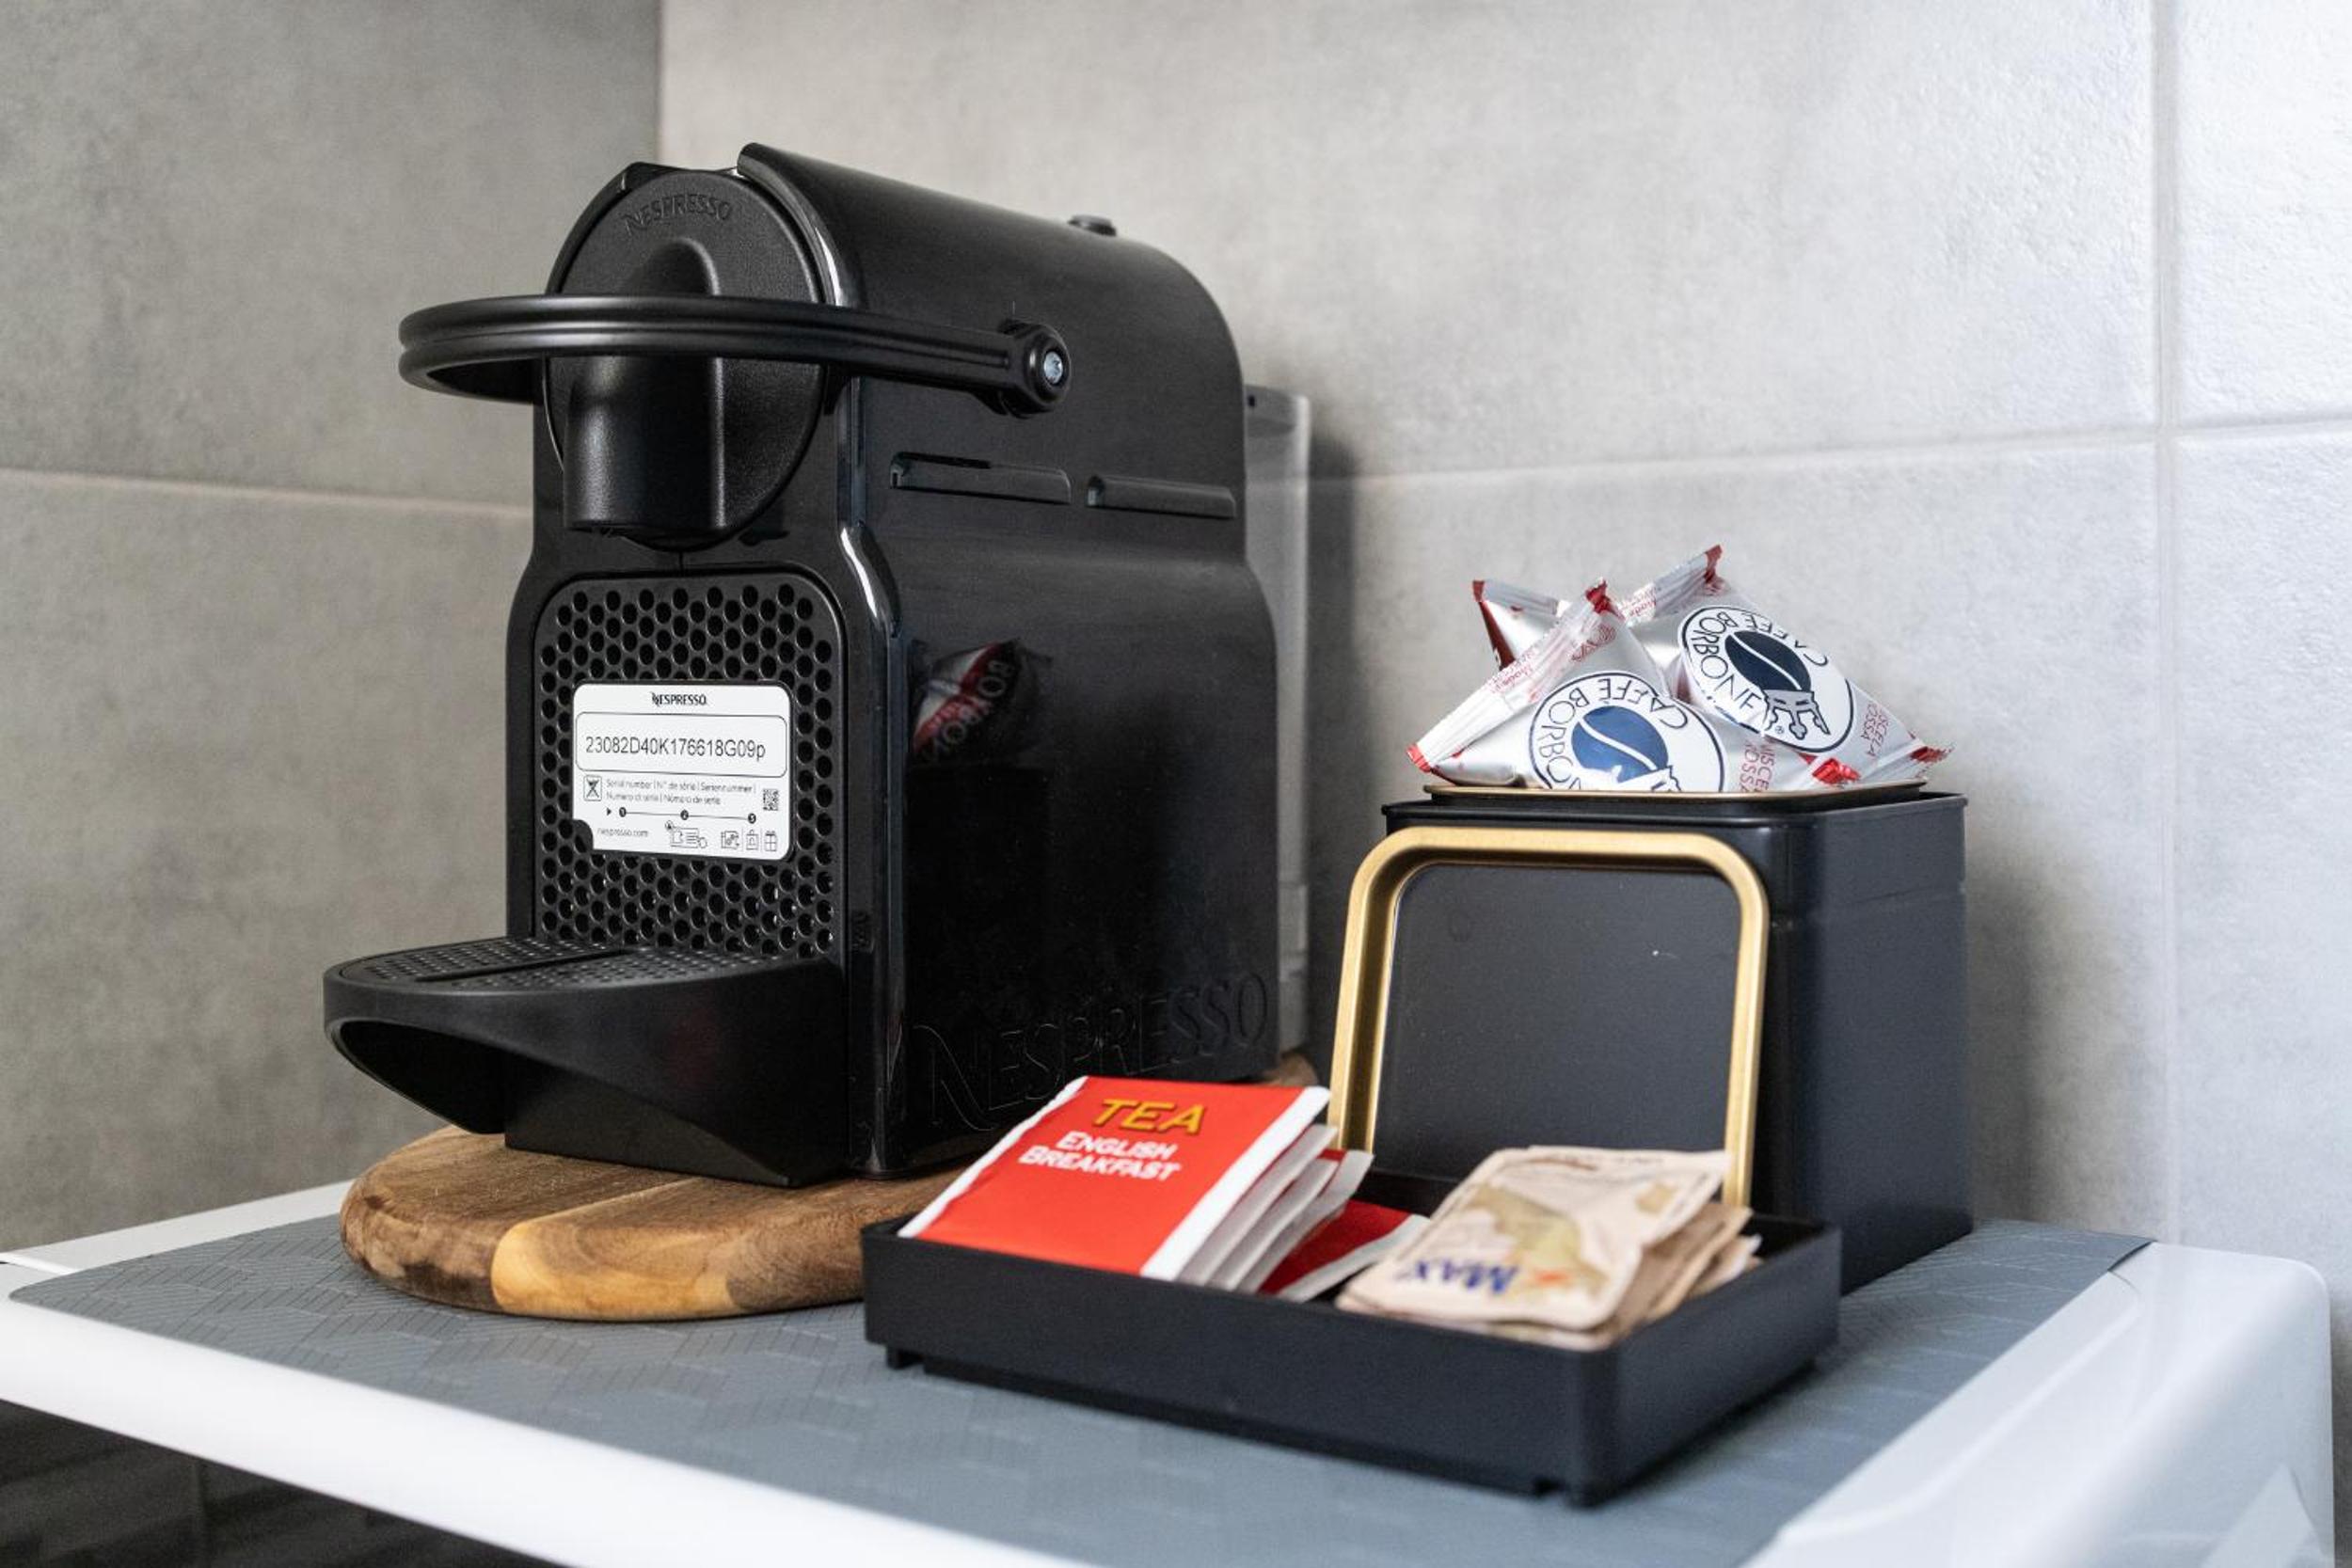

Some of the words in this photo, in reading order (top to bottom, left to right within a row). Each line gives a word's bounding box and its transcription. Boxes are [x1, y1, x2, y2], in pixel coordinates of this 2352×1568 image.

[621, 192, 732, 235] NESPRESSO
[1690, 610, 1762, 710] BORBONE
[651, 691, 707, 707] NESPRESSO
[585, 735, 767, 761] 23082D40K176618G09p
[1536, 686, 1591, 790] BORBO
[913, 973, 1268, 1132] NESPRESSO
[1092, 1098, 1206, 1135] TEA
[1018, 1145, 1183, 1181] BREAKFAST
[1056, 1131, 1179, 1160] ENGLISH
